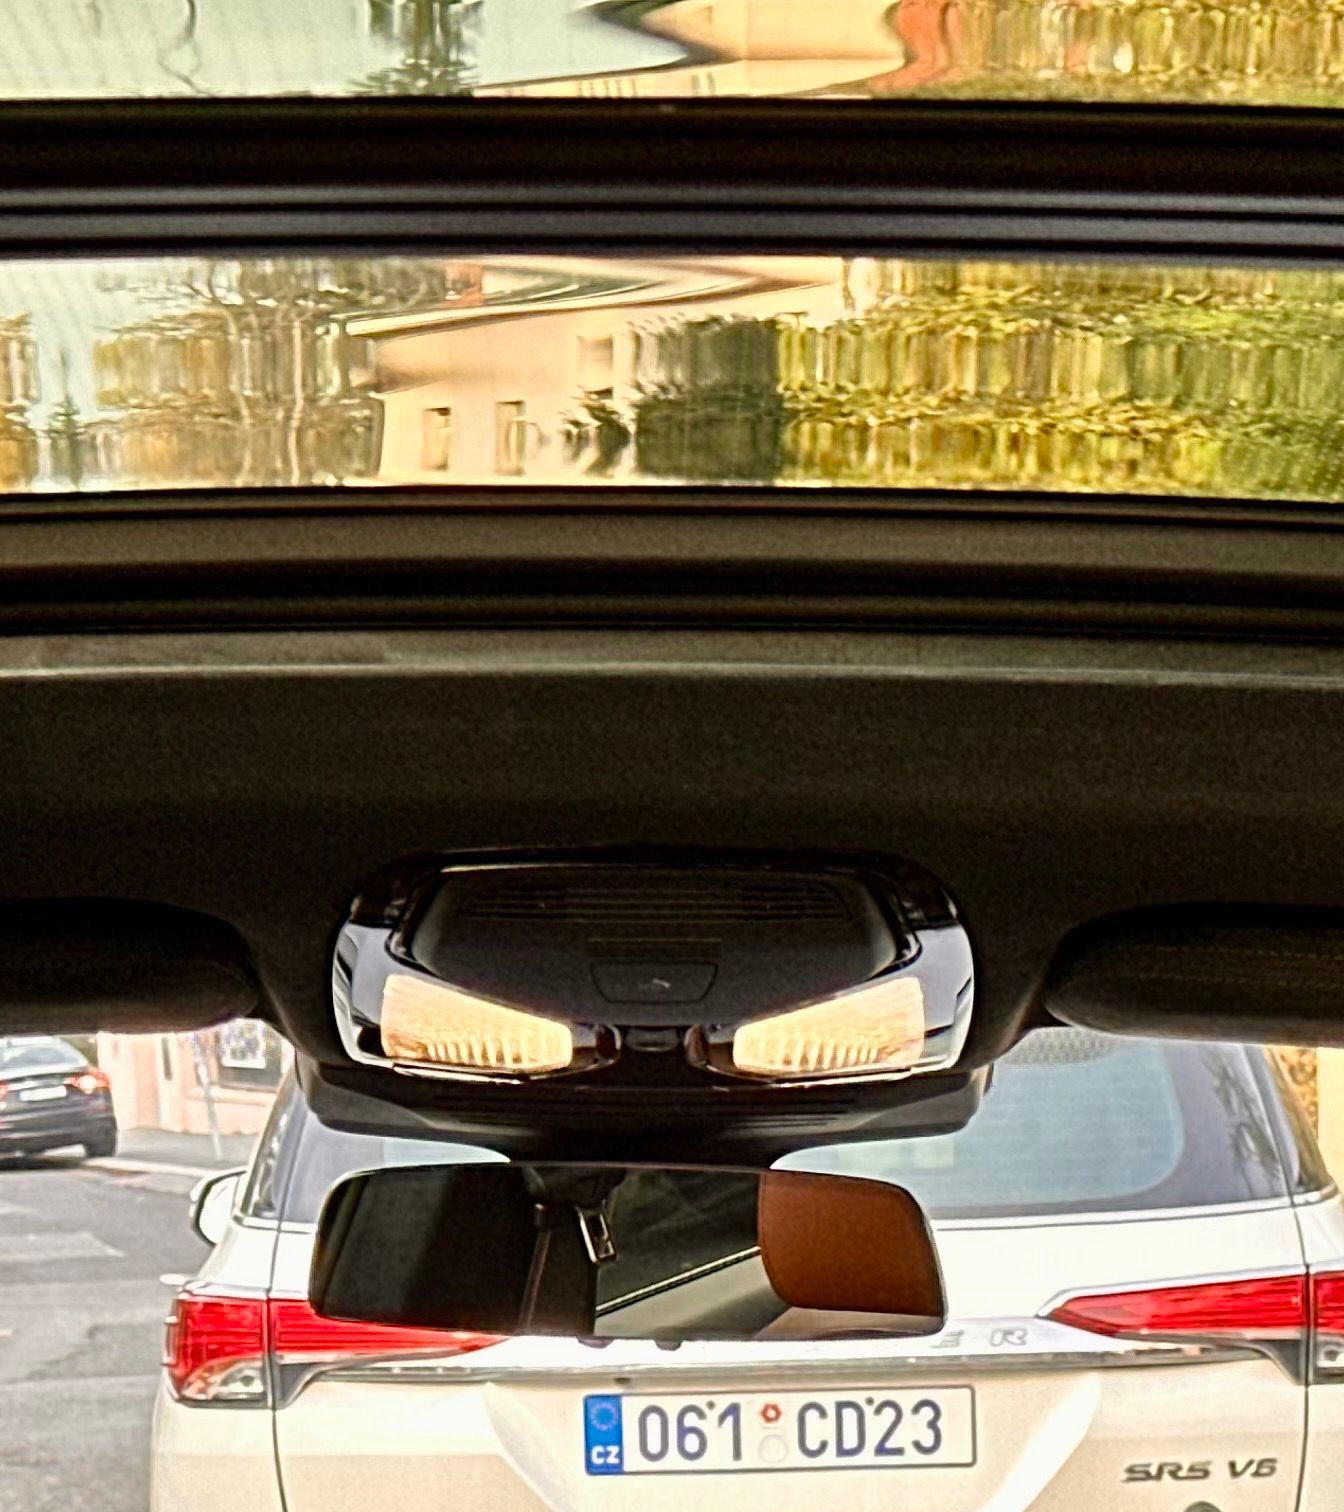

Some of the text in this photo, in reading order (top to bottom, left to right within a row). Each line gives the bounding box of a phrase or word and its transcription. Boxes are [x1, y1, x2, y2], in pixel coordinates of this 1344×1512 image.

[637, 1398, 943, 1463] 061 CD23
[591, 1444, 621, 1465] CZ
[1228, 1458, 1278, 1480] V6
